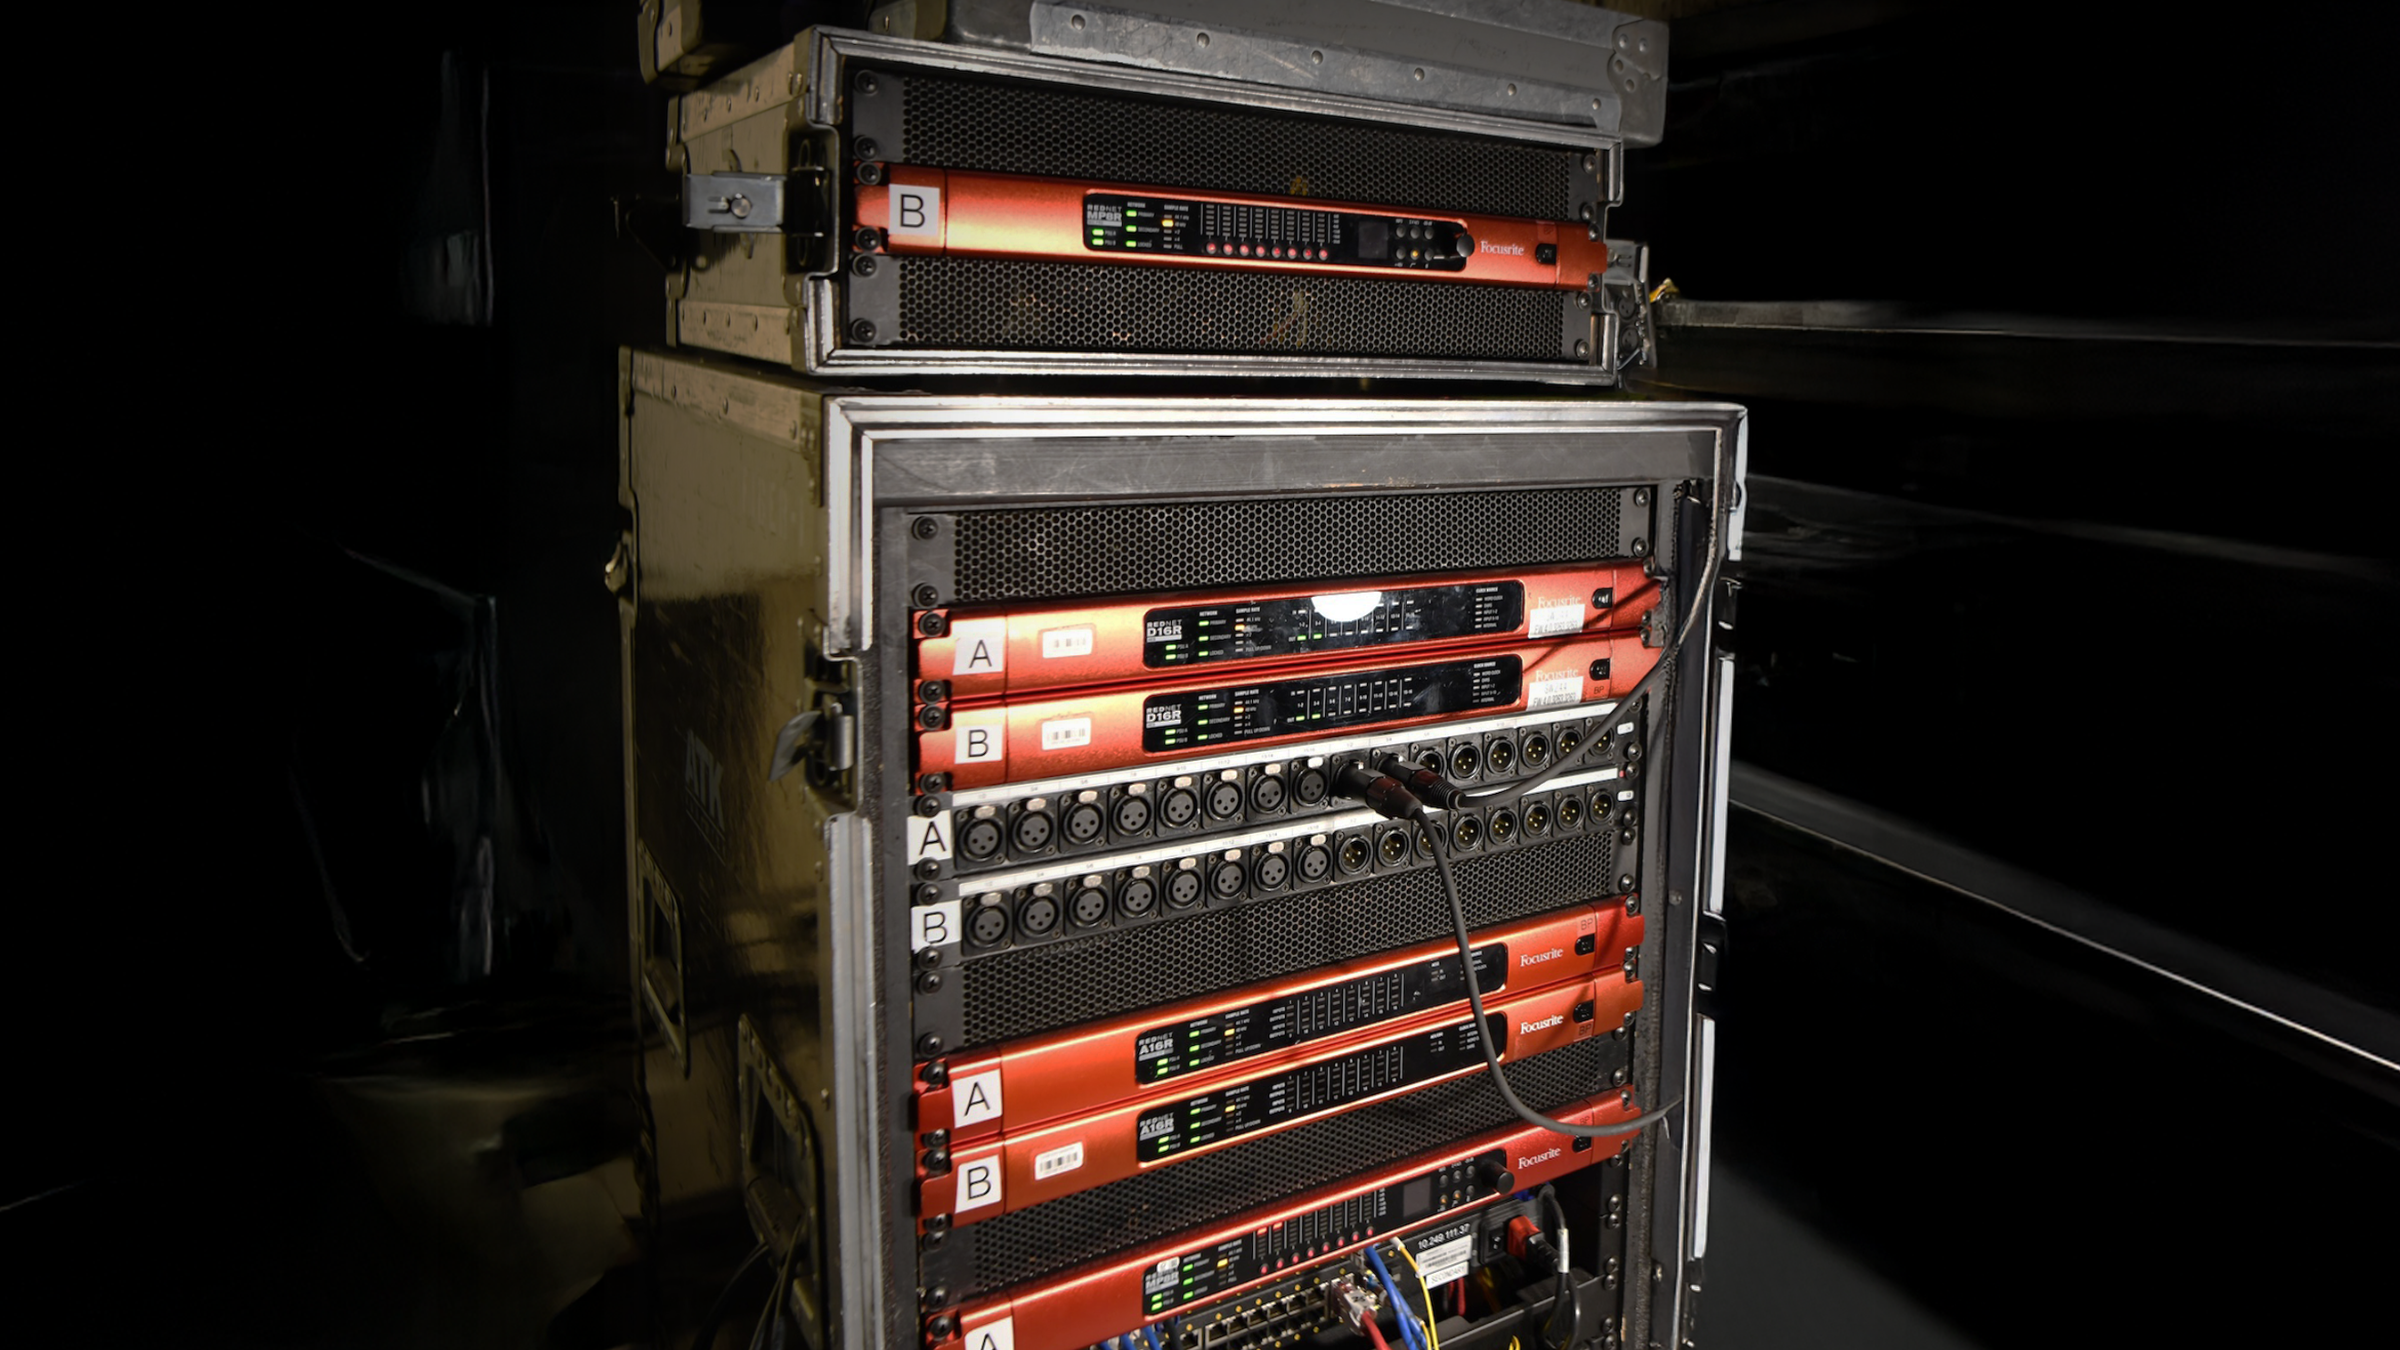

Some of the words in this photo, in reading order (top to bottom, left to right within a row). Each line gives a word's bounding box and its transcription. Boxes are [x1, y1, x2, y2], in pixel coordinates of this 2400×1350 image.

[899, 194, 926, 228] B
[1087, 211, 1122, 222] MP8R
[1480, 240, 1525, 256] Focusrite
[1538, 596, 1582, 609] Focusrite
[1146, 619, 1182, 628] REDNET
[1146, 626, 1182, 637] D16R
[968, 639, 993, 669] A
[1535, 667, 1578, 683] Focusrite
[1594, 685, 1605, 694] BP
[1146, 703, 1182, 714] REDNET
[1146, 710, 1182, 722] D16R
[968, 729, 989, 758] B
[684, 728, 726, 833] ATK
[918, 820, 948, 856] A
[924, 910, 948, 944] B
[1580, 918, 1593, 931] BP
[1520, 948, 1564, 968] Focusrite
[1520, 1014, 1564, 1035] Focusrite
[1578, 1023, 1592, 1036] BP
[1138, 1038, 1174, 1056] A16R
[963, 1081, 990, 1117] A
[1140, 1118, 1174, 1135] A16R
[1518, 1147, 1562, 1170] Focusrite
[967, 1166, 992, 1201] B
[1418, 1222, 1470, 1250] 10.249.111.37
[1146, 1271, 1180, 1290] MP8R
